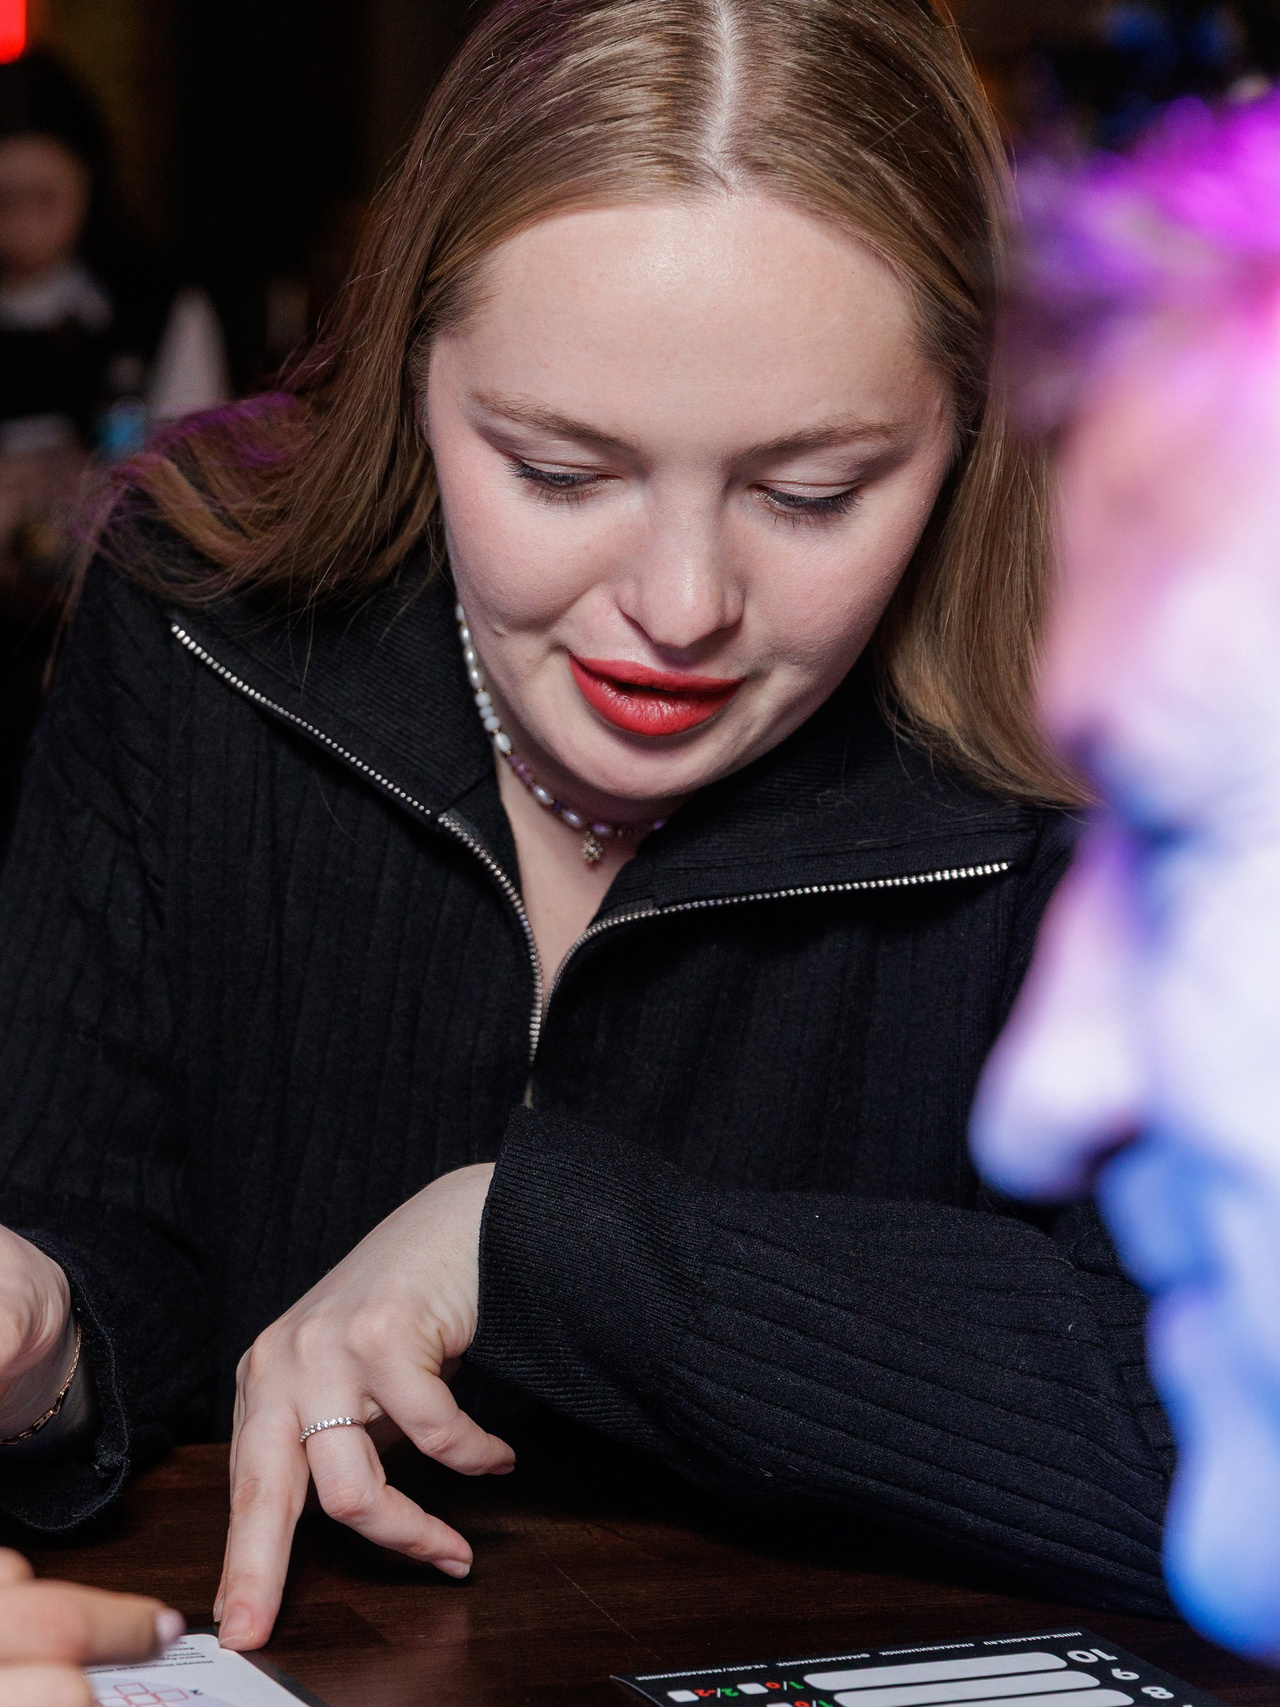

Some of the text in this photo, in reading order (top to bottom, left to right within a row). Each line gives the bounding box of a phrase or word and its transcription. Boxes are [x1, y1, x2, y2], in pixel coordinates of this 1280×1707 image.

[1067, 1648, 1118, 1663] 10
[1111, 1668, 1140, 1680] 9
[1141, 1686, 1174, 1699] 8
